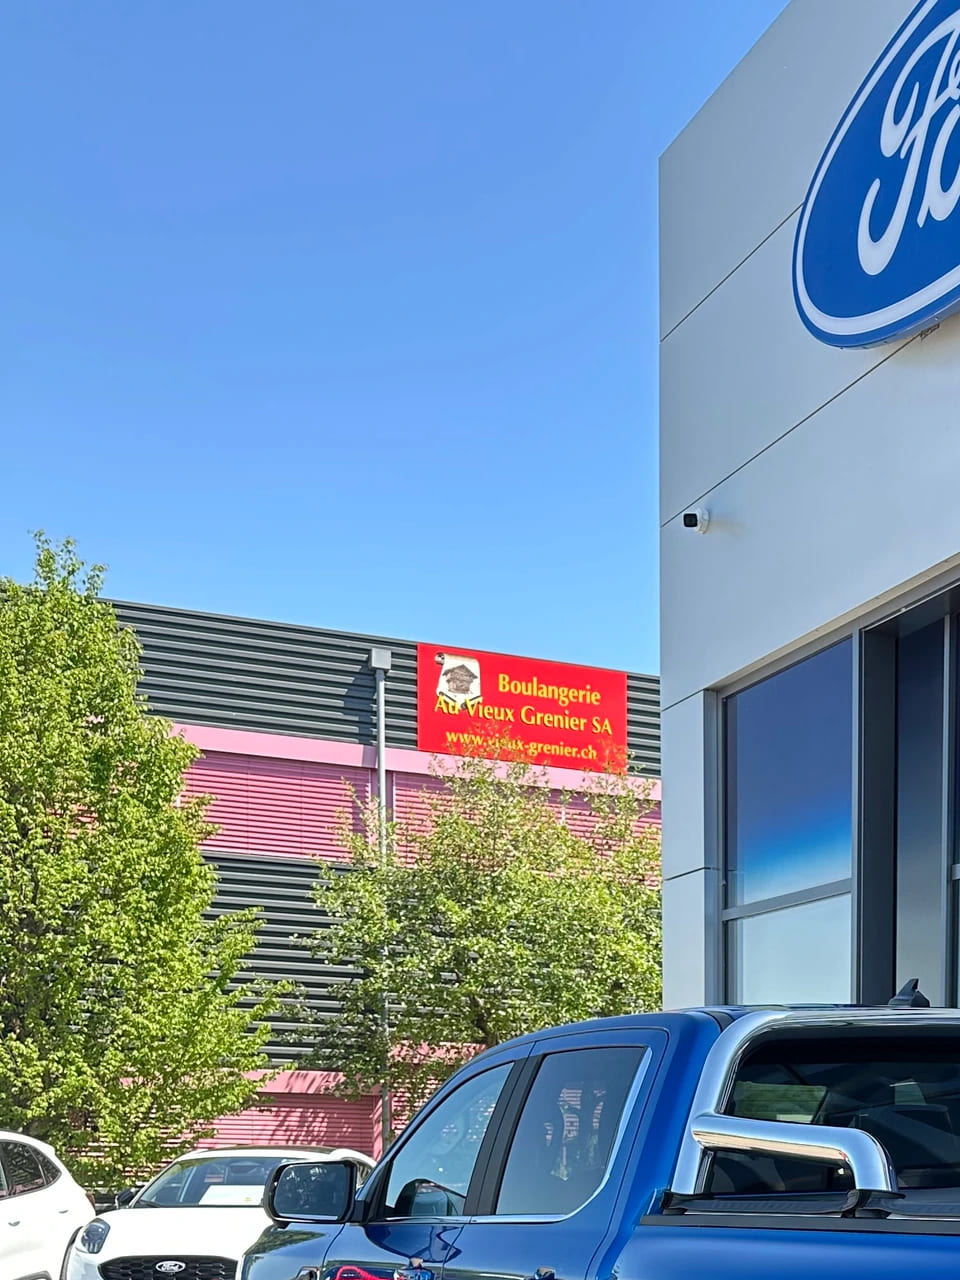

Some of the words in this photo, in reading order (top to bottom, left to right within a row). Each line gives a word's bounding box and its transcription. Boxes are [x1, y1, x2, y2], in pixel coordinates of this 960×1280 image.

[497, 673, 601, 706] Boulangerie
[434, 695, 459, 715] Au
[464, 697, 515, 723] Vieux
[520, 705, 588, 733] Grenier
[591, 716, 613, 735] SA
